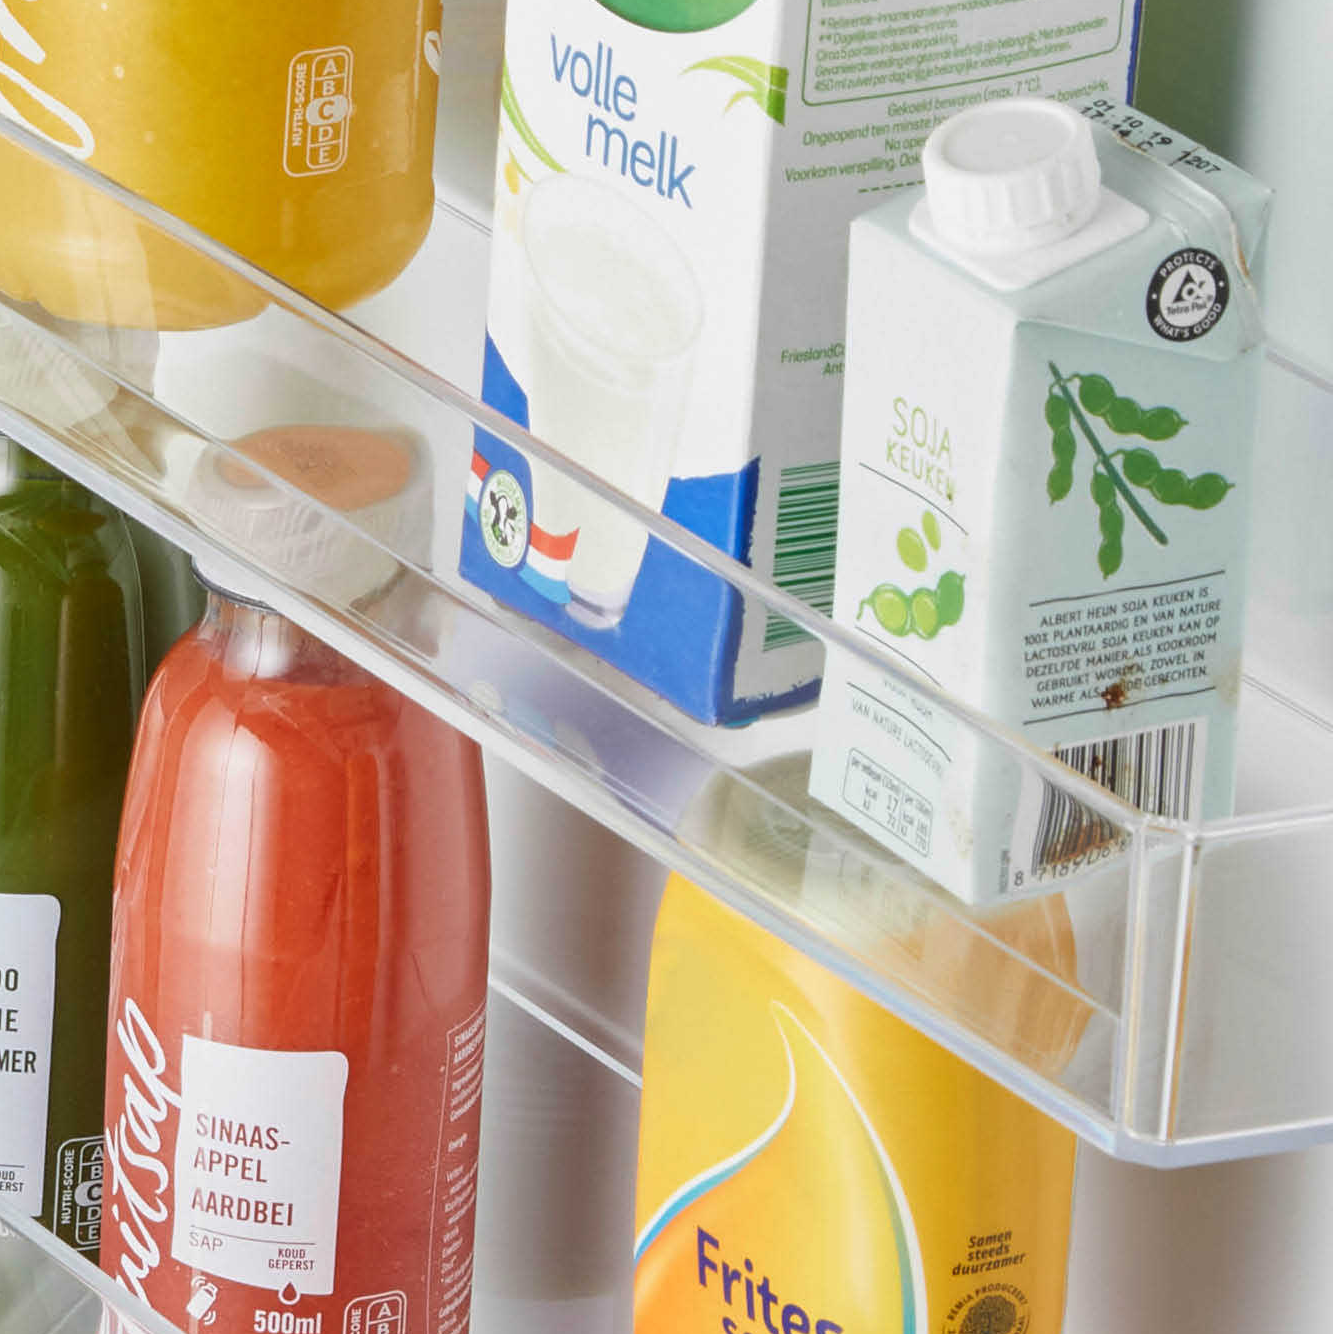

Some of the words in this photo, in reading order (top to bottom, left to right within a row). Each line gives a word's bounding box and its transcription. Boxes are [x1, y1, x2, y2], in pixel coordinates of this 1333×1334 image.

[550, 33, 637, 121] volle
[292, 62, 307, 147] NUTRI-SCORE
[802, 124, 870, 148] Ongeopend
[586, 113, 695, 209] melk
[1160, 250, 1217, 279] PROTECTS
[1153, 314, 1190, 340] WHAT'S
[1193, 301, 1222, 337] GOOD
[892, 396, 953, 471] SOJA
[885, 438, 957, 506] KEUKEN
[1040, 608, 1081, 628] ALBERT
[1122, 598, 1149, 613] SOJA
[1152, 590, 1195, 608] KEUKEN
[1198, 585, 1210, 598] IS
[1053, 618, 1130, 642] PLANTAARDIG
[1133, 615, 1150, 628] EN
[1151, 608, 1175, 624] VAN
[1179, 598, 1222, 617] NATURE
[1101, 633, 1129, 649] SOJA
[1132, 624, 1175, 644] KEUKEN
[1178, 620, 1202, 637] KAN
[1204, 614, 1221, 629] OP
[1025, 659, 1081, 679] DEZELFDE
[1085, 649, 1129, 668] MANIER
[1132, 642, 1153, 658] ALS
[1156, 632, 1218, 654] KOOKROOM
[1036, 674, 1090, 693] GEBRUIKT
[1149, 653, 1190, 671] ZOWEL
[1193, 650, 1205, 662] IN
[1031, 690, 1076, 709] WARME
[1079, 684, 1101, 701] ALS
[196, 1113, 291, 1151] SINAAS-
[193, 1146, 267, 1184] APPEL
[61, 1148, 75, 1225] NUTRI-SCORE
[190, 1186, 294, 1227] AARDBEI
[188, 1230, 223, 1252] SAP
[277, 1247, 307, 1260] KOUD
[967, 1244, 1010, 1262] steeds
[968, 1230, 1013, 1249] Samen
[268, 1257, 315, 1271] GEPERST
[951, 1252, 1026, 1276] duurzamer
[377, 1302, 391, 1319] A
[947, 1293, 974, 1322] REMIA
